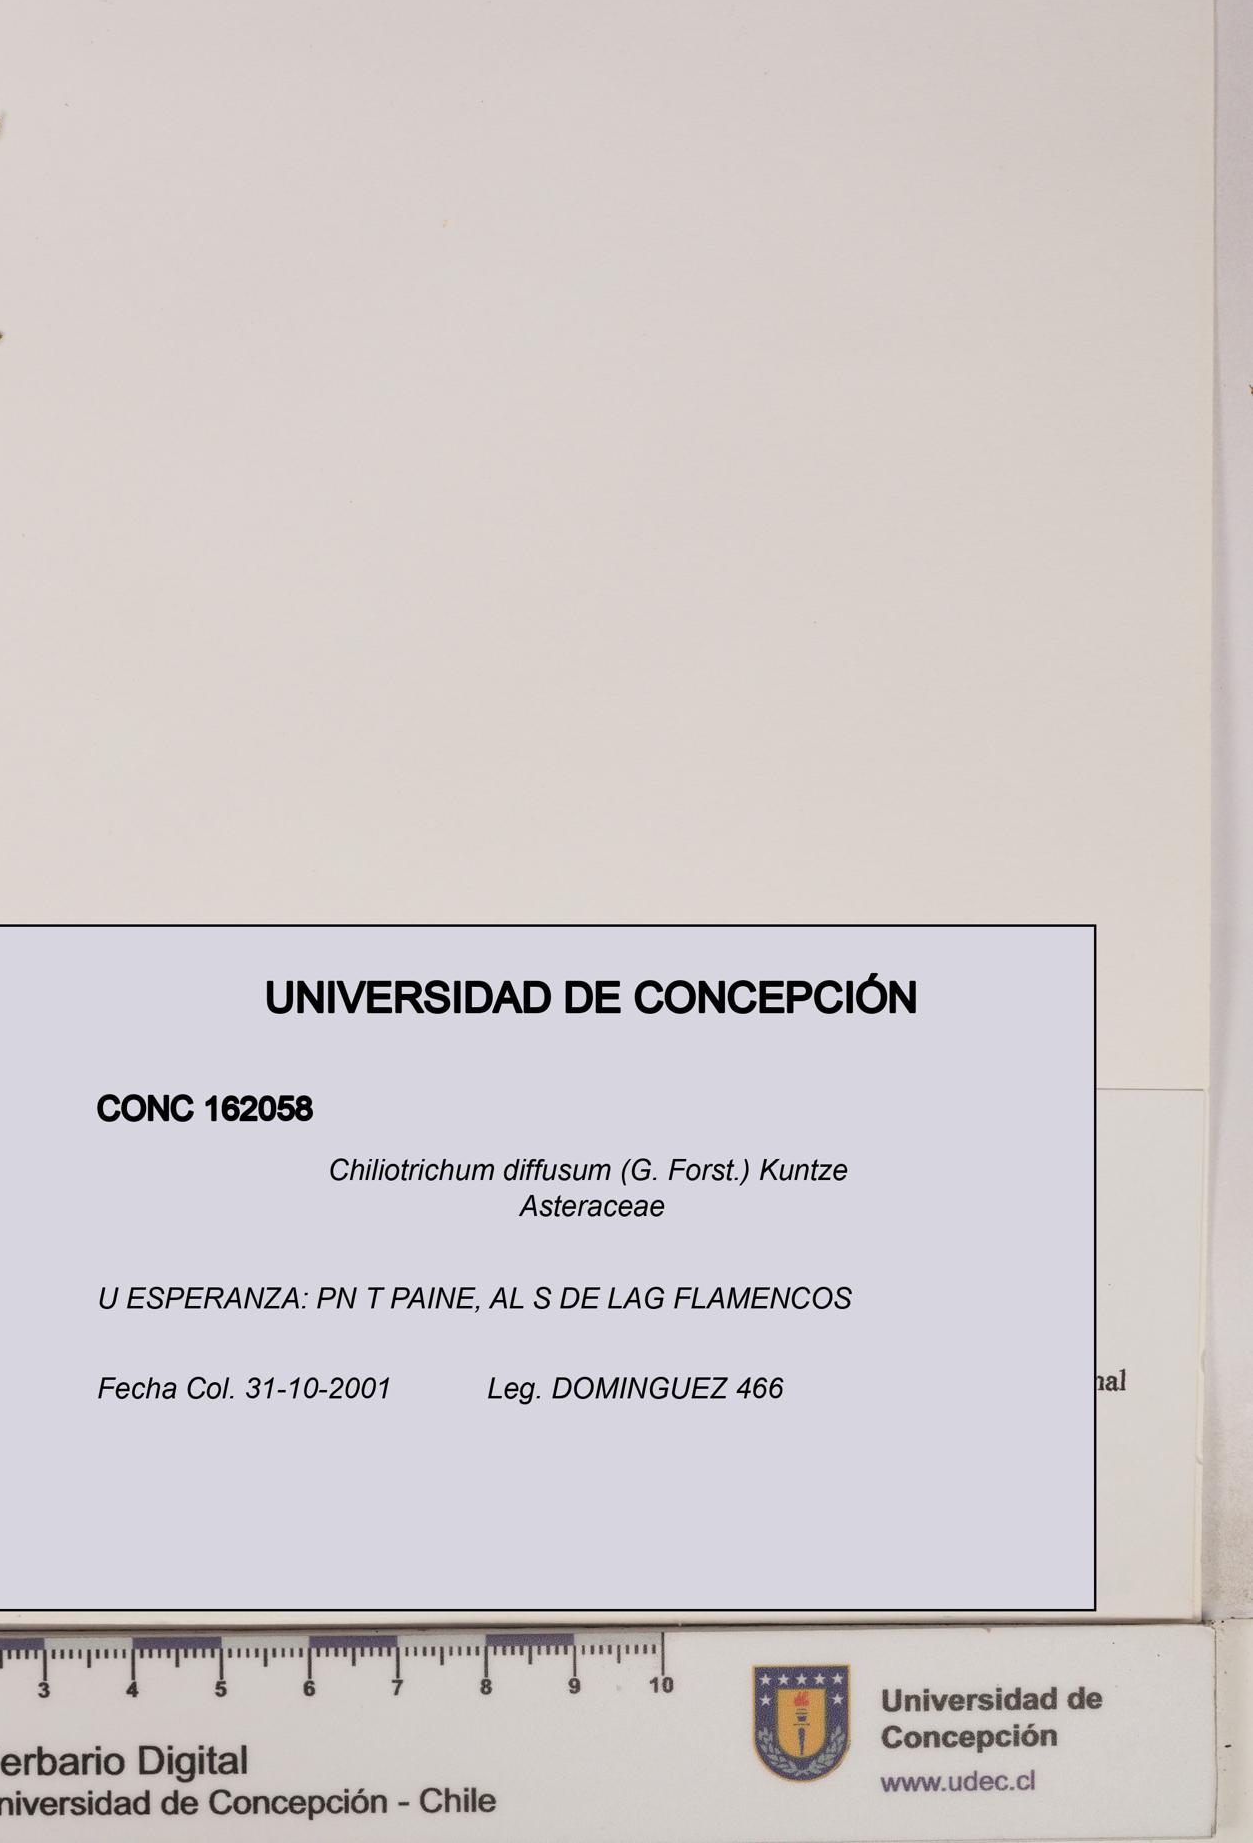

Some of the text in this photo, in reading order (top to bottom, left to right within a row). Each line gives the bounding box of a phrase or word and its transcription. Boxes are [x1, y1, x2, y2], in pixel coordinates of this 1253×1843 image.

[37, 1681, 51, 1699] 3
[125, 1680, 140, 1698] 4
[214, 1680, 228, 1698] 5
[302, 1679, 316, 1697] 6
[391, 1678, 404, 1696] 7
[479, 1678, 493, 1696] 8
[567, 1677, 581, 1695] 9
[649, 1676, 674, 1694] 10
[881, 1685, 1103, 1713] Universidad de
[880, 1723, 1058, 1754] Concepción
[138, 1744, 248, 1783] Digital
[879, 1768, 1036, 1793] www.udec.cl
[160, 1788, 200, 1816] de
[208, 1787, 388, 1821] Concepción
[419, 1786, 497, 1814] Chile
